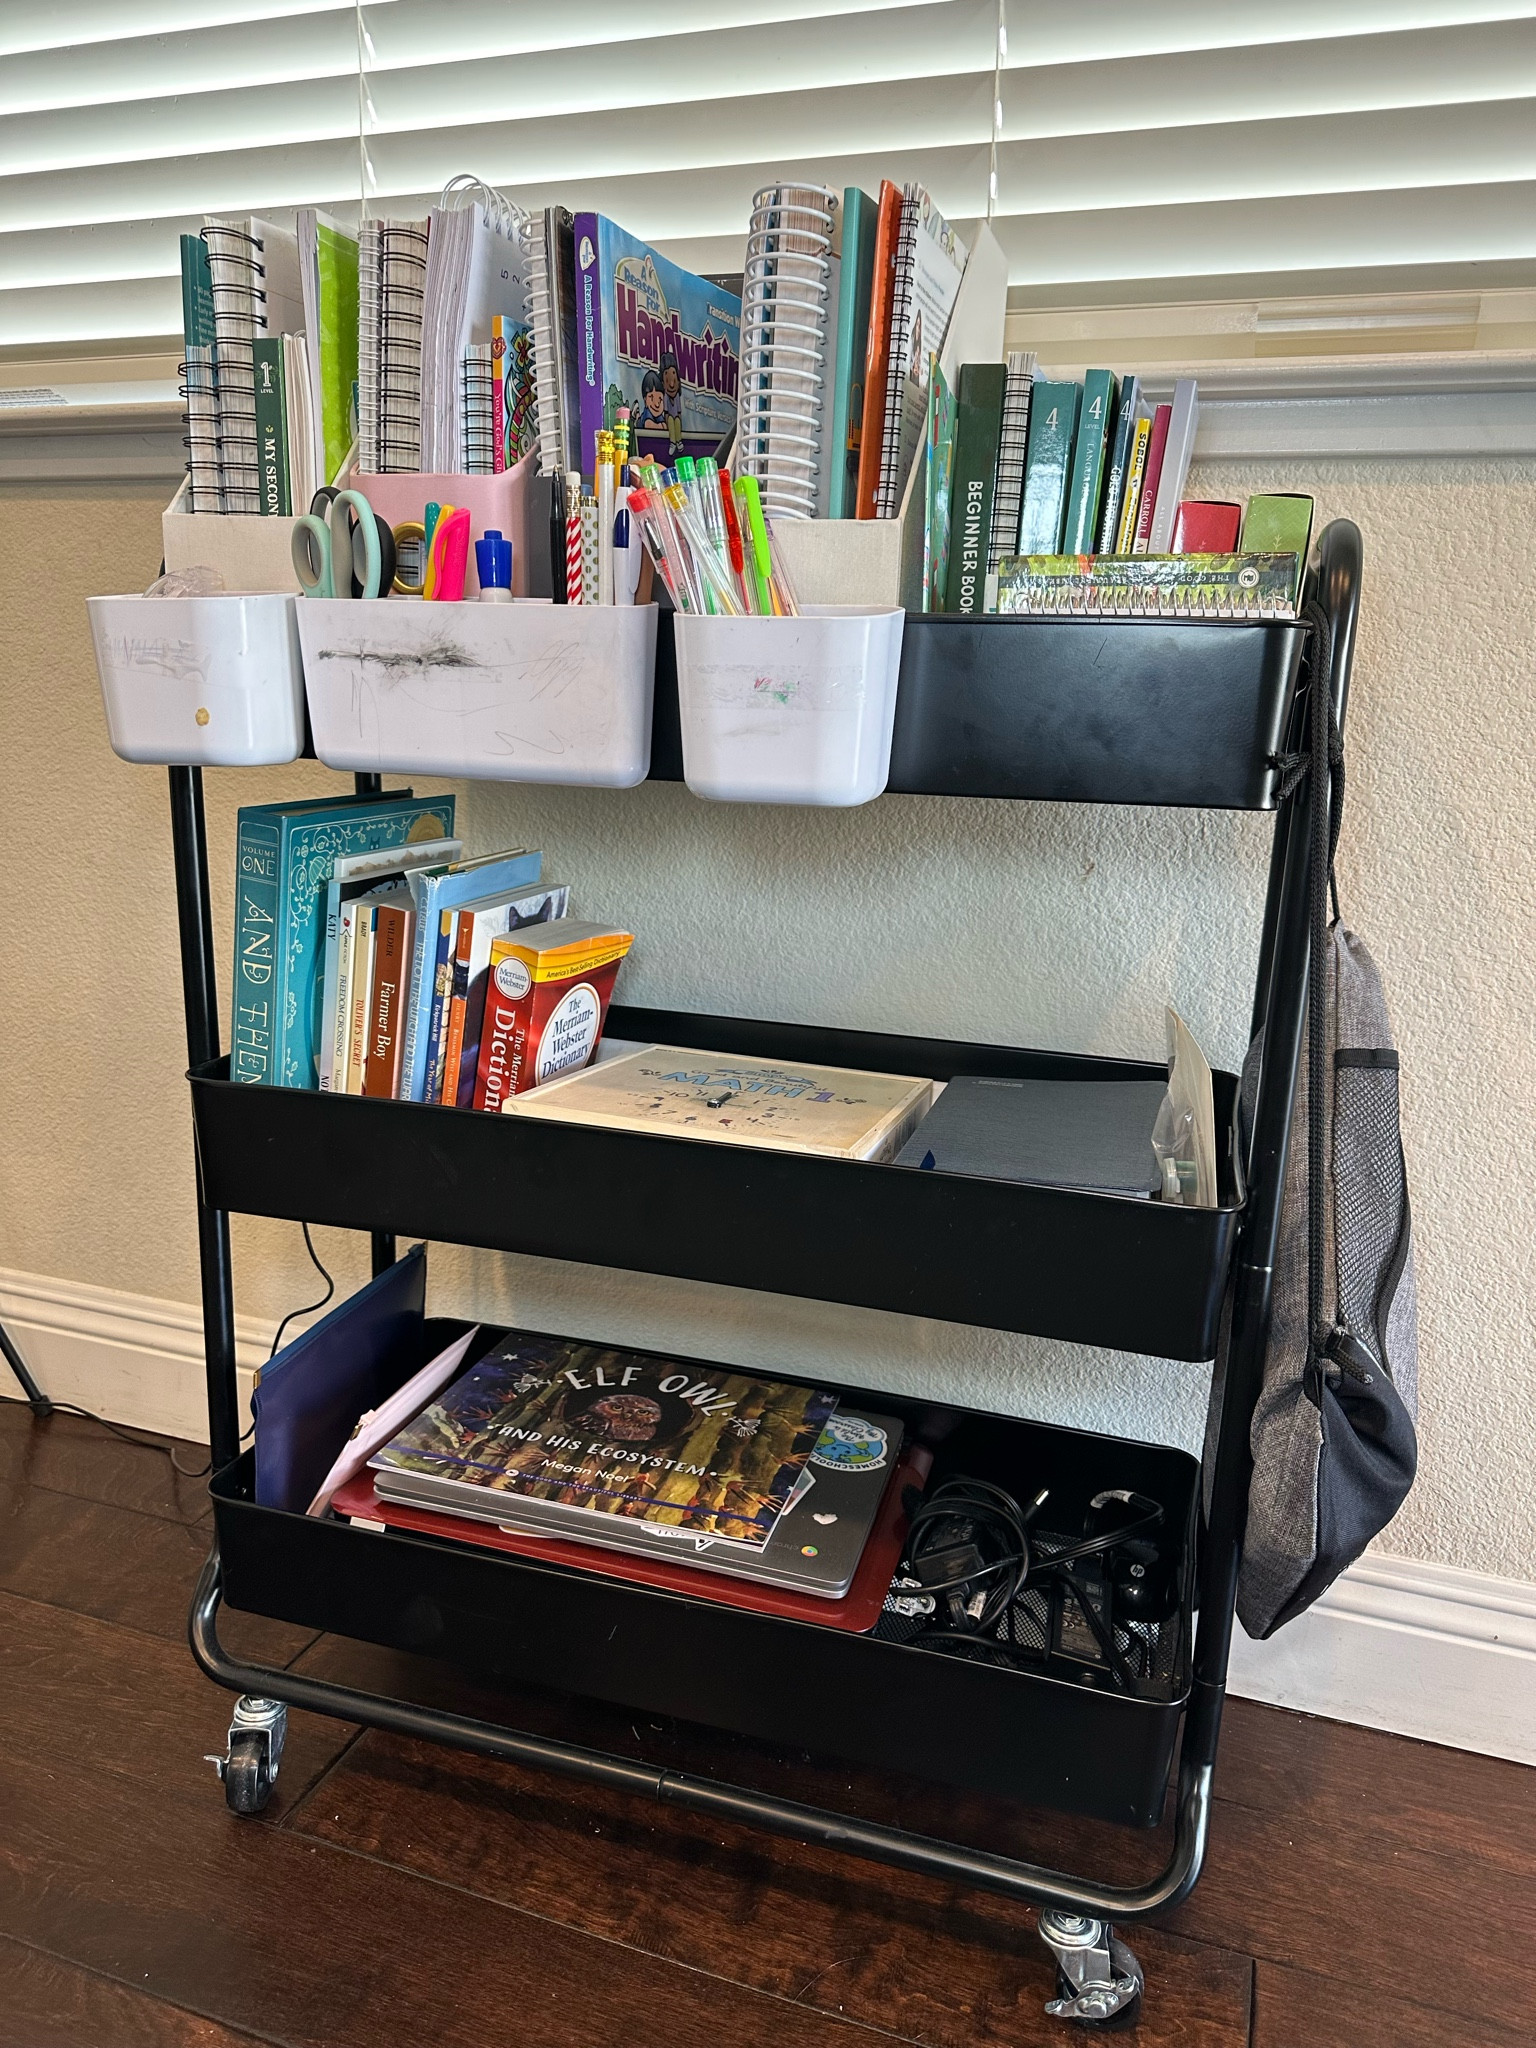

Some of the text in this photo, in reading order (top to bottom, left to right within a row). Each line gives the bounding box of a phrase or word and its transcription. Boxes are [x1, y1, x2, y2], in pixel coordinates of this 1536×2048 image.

[584, 274, 592, 283] A
[624, 266, 659, 300] Reason
[584, 284, 592, 315] Reason
[646, 296, 660, 312] For
[260, 361, 272, 387] 1
[1045, 407, 1059, 430] 4
[1088, 395, 1102, 420] 4
[1120, 399, 1130, 420] 4
[264, 437, 276, 462] MY
[1134, 432, 1147, 471] SOBOL
[962, 481, 983, 571] BEGINNER
[1154, 524, 1163, 550] ABOUT
[242, 845, 276, 858] VOLUME
[241, 856, 276, 877] ONE
[242, 894, 274, 984] AND
[327, 913, 337, 941] KATY
[385, 920, 396, 957] WILDER
[546, 951, 620, 979] America's Best-Selling Dictionary
[338, 974, 347, 1013] FREEDOM
[499, 975, 525, 990] Webster
[569, 998, 581, 1013] The
[351, 999, 364, 1067] TOLIVER'S SECRET
[373, 981, 396, 1060] Farmer Boy
[552, 1009, 593, 1037] Merriam-
[335, 1013, 346, 1057] CROSSING
[513, 1029, 525, 1050] The
[552, 1028, 587, 1055] Webster
[541, 1042, 590, 1079] Dictionary
[657, 1072, 835, 1103] MATH 1
[564, 1366, 738, 1417] ELF OWL
[498, 1426, 706, 1477] AND HIS ECOSYSTEM
[541, 1459, 592, 1476] Megan
[1131, 1564, 1144, 1577] hp
